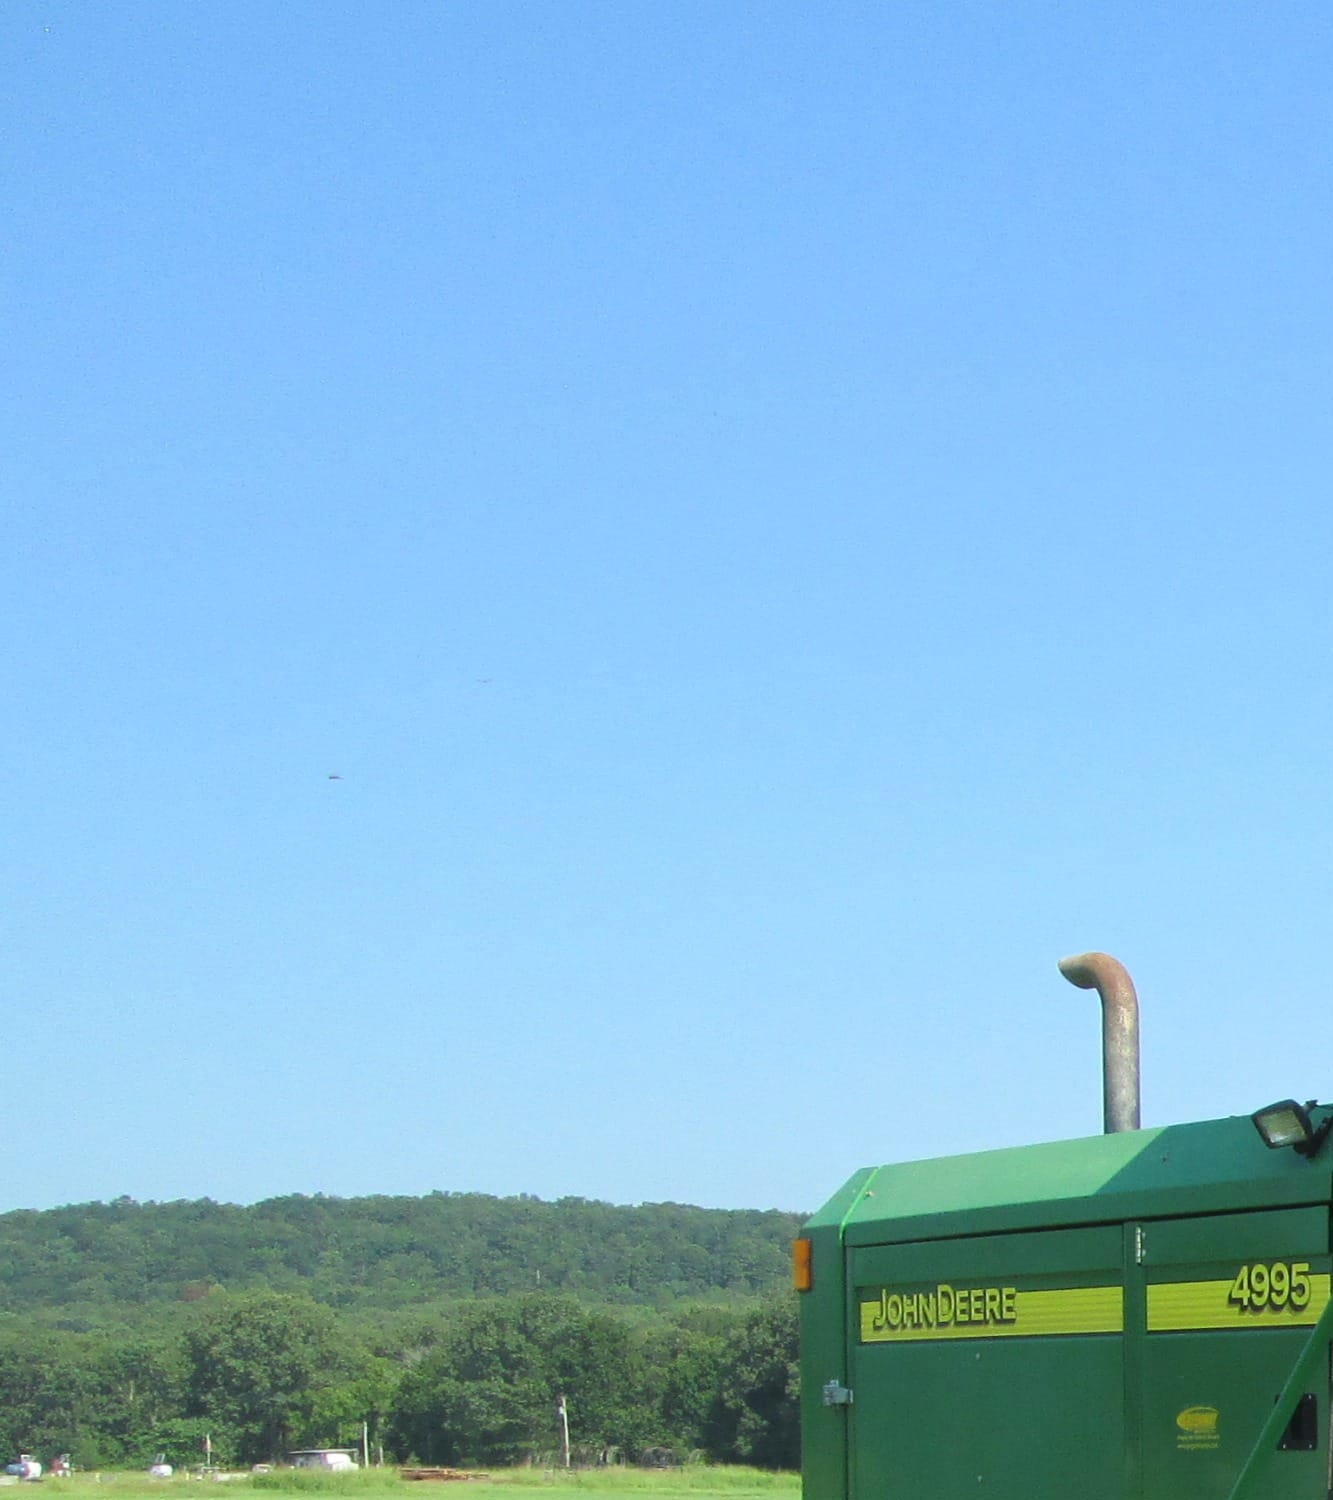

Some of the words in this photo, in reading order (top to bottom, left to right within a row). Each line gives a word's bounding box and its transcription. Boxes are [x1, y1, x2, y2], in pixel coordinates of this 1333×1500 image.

[872, 1288, 936, 1329] JOHN
[936, 1284, 1017, 1324] DEERE
[1230, 1262, 1312, 1309] 4995
